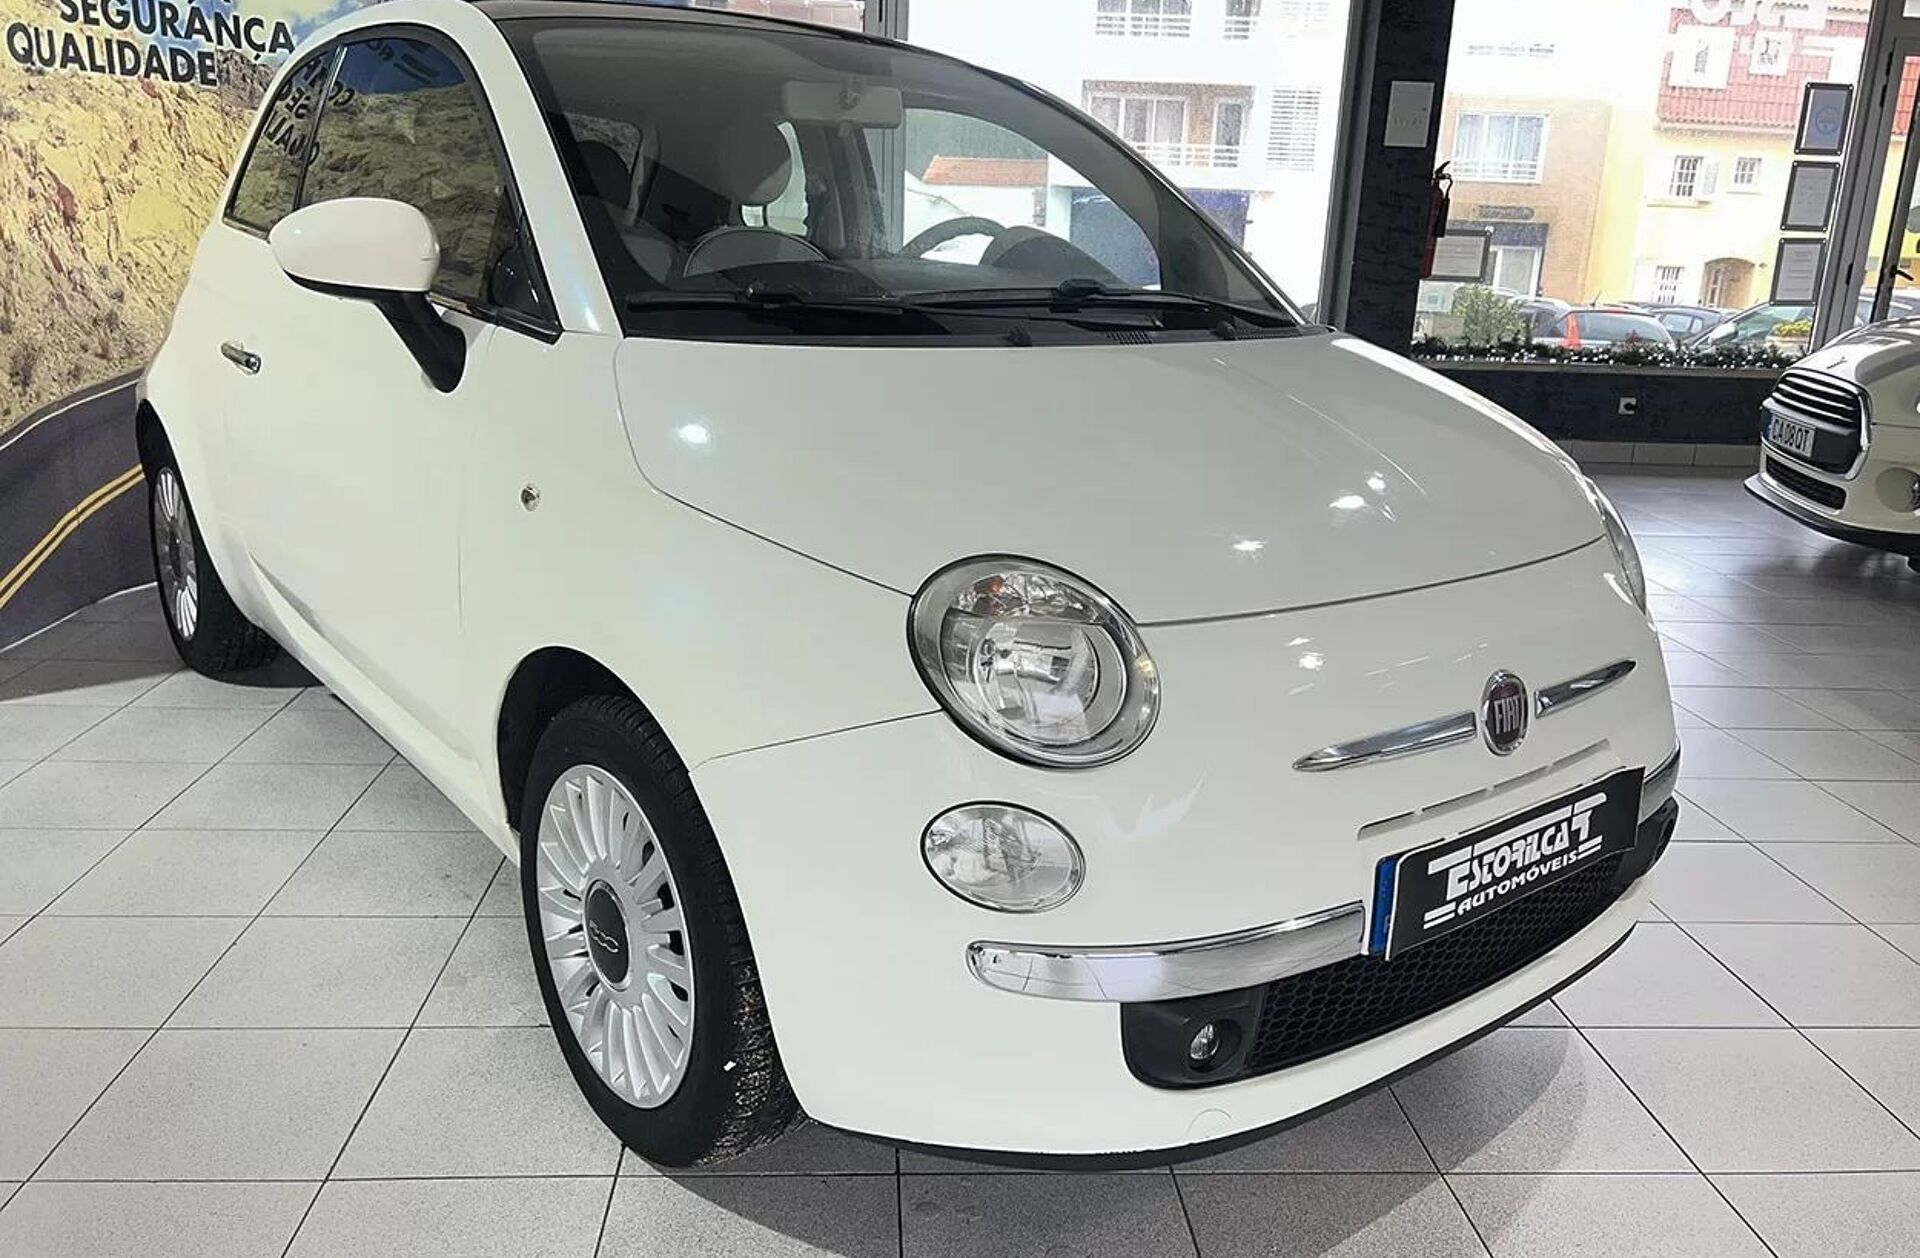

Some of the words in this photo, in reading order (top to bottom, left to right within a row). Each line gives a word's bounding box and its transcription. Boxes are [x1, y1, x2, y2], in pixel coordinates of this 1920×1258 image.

[6, 22, 217, 86] QUALIDADE
[59, 0, 296, 61] SEGURANÇA
[1494, 694, 1520, 735] FIAT
[1456, 851, 1577, 915] AUTOMÓVEIS
